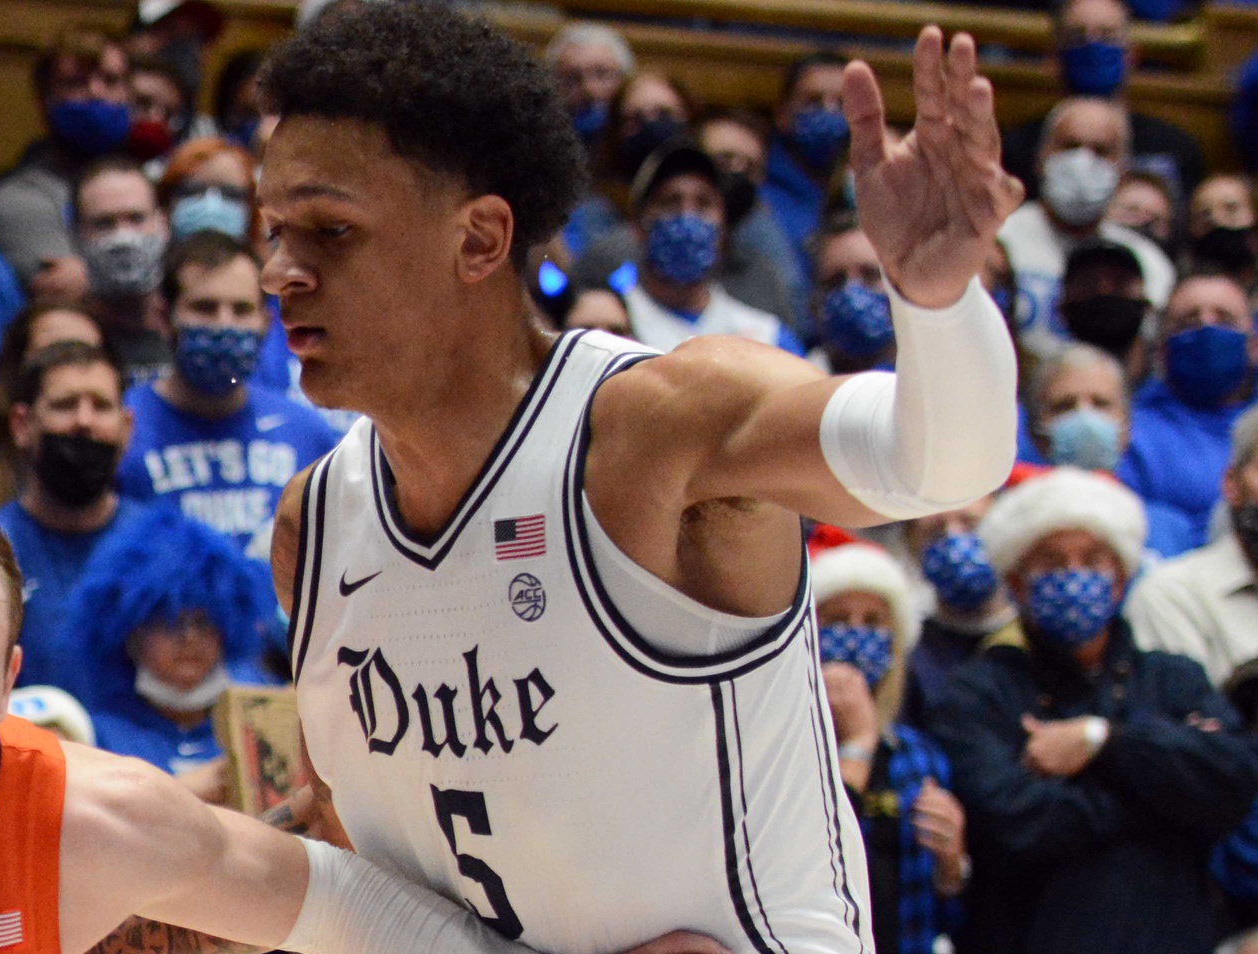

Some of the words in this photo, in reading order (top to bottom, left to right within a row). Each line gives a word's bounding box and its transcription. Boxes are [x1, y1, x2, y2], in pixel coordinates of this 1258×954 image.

[144, 439, 245, 494] LET'S
[247, 438, 297, 488] GO
[514, 586, 542, 602] ACC
[337, 644, 559, 759] Duke
[430, 783, 524, 941] 5
